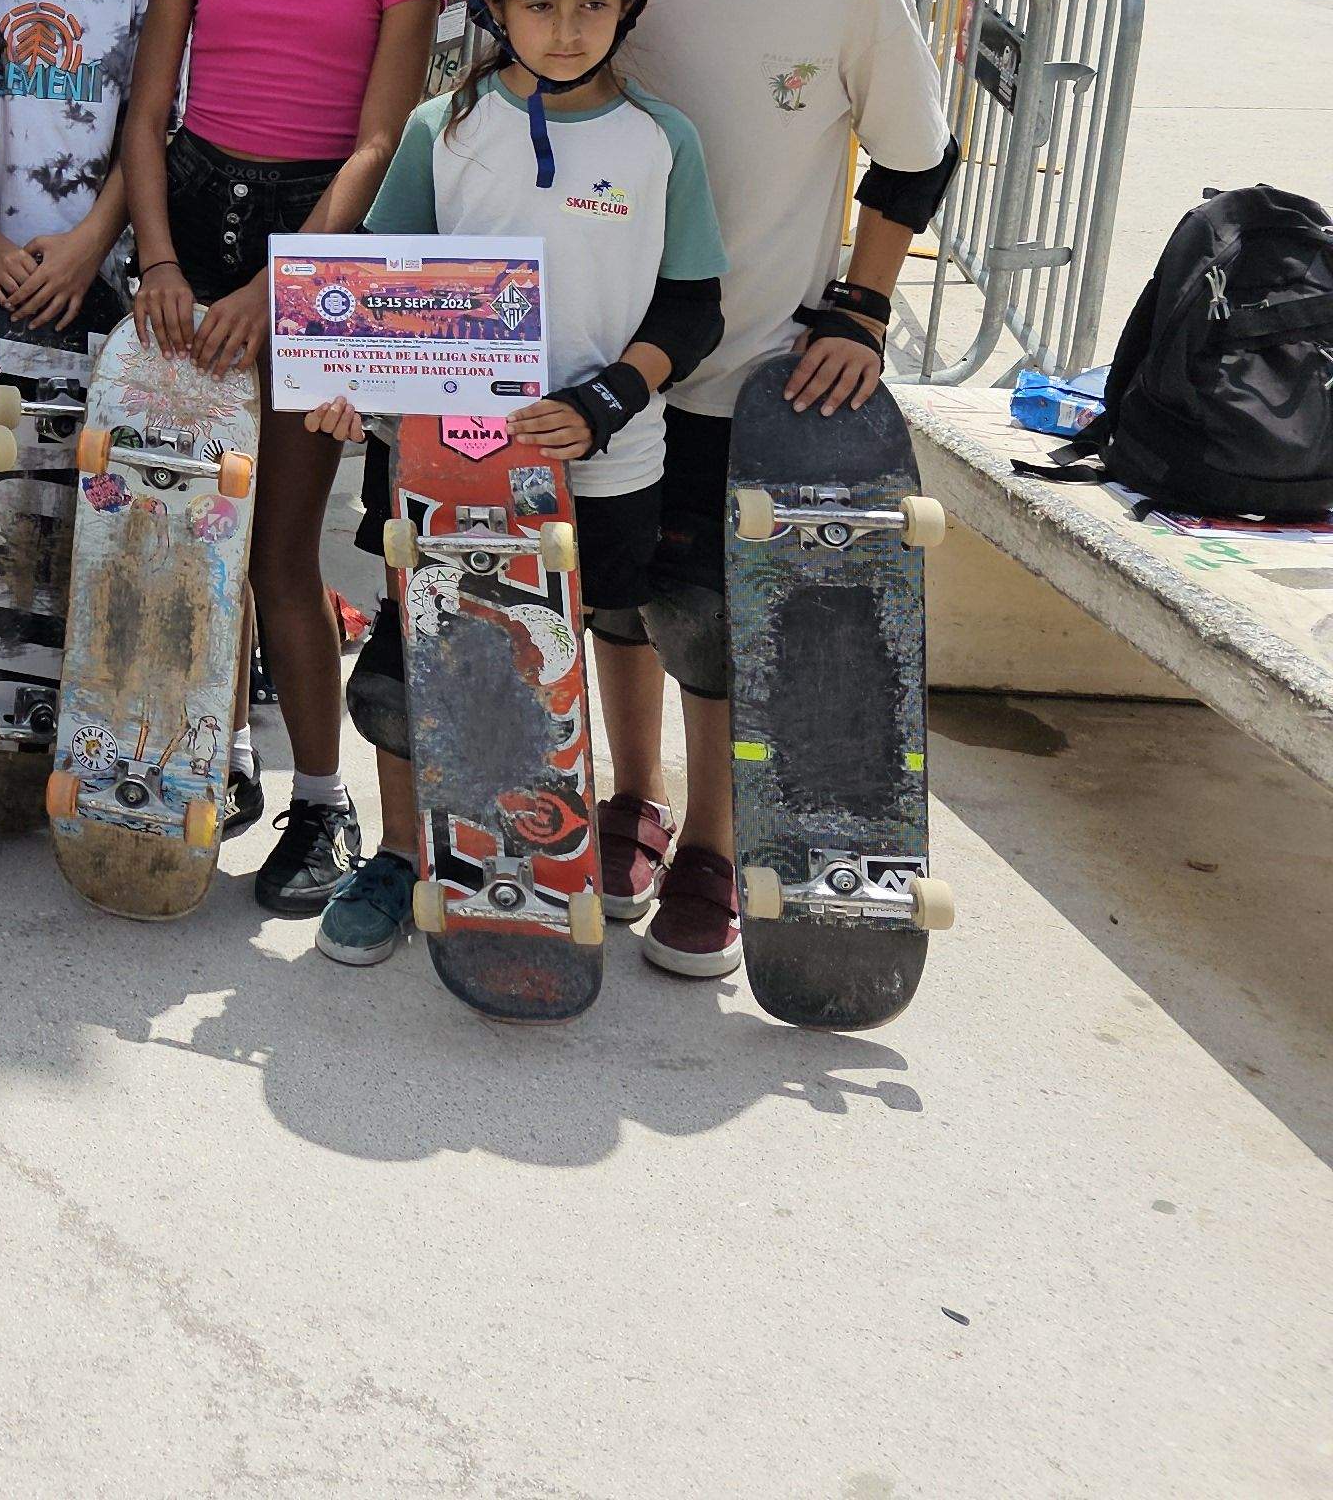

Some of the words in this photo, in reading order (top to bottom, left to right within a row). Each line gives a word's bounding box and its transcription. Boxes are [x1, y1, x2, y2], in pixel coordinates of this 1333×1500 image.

[565, 196, 598, 211] SKATE
[600, 201, 629, 216] CLUB
[367, 296, 402, 308] 13-15
[404, 296, 437, 310] SEPT.
[440, 298, 472, 310] 2024
[276, 347, 349, 360] COMPETICIÓ
[353, 350, 393, 361] EXTRA
[395, 351, 413, 361] DE
[414, 351, 430, 361] LA
[432, 351, 468, 362] LLIGA
[470, 352, 511, 363] SKATE
[514, 353, 540, 364] BCN
[323, 363, 352, 374] DINS
[369, 364, 418, 375] EXTREM
[421, 365, 495, 377] BARCELONA
[447, 428, 505, 440] KAINA
[74, 728, 104, 746] MARIA
[76, 751, 100, 770] TRUE
